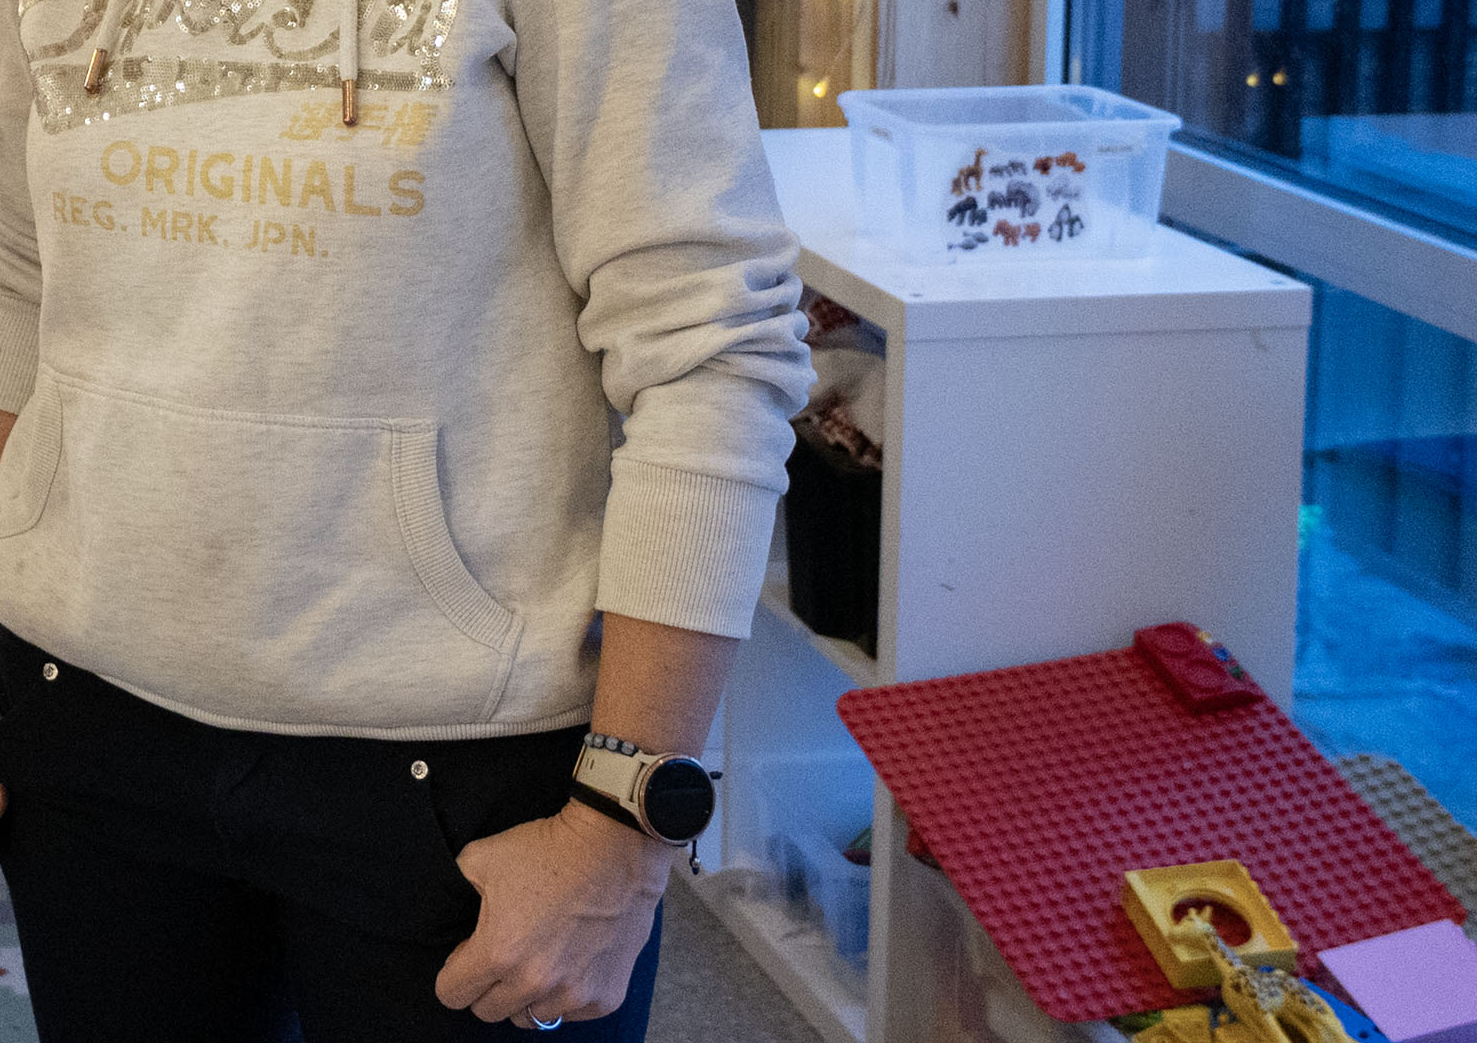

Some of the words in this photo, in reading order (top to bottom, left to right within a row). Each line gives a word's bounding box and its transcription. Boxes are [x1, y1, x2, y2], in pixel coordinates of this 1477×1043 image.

[100, 139, 426, 217] ORIGINALS
[51, 190, 128, 233] REG.
[140, 206, 230, 249] MRK.
[246, 218, 329, 259] JPN.
